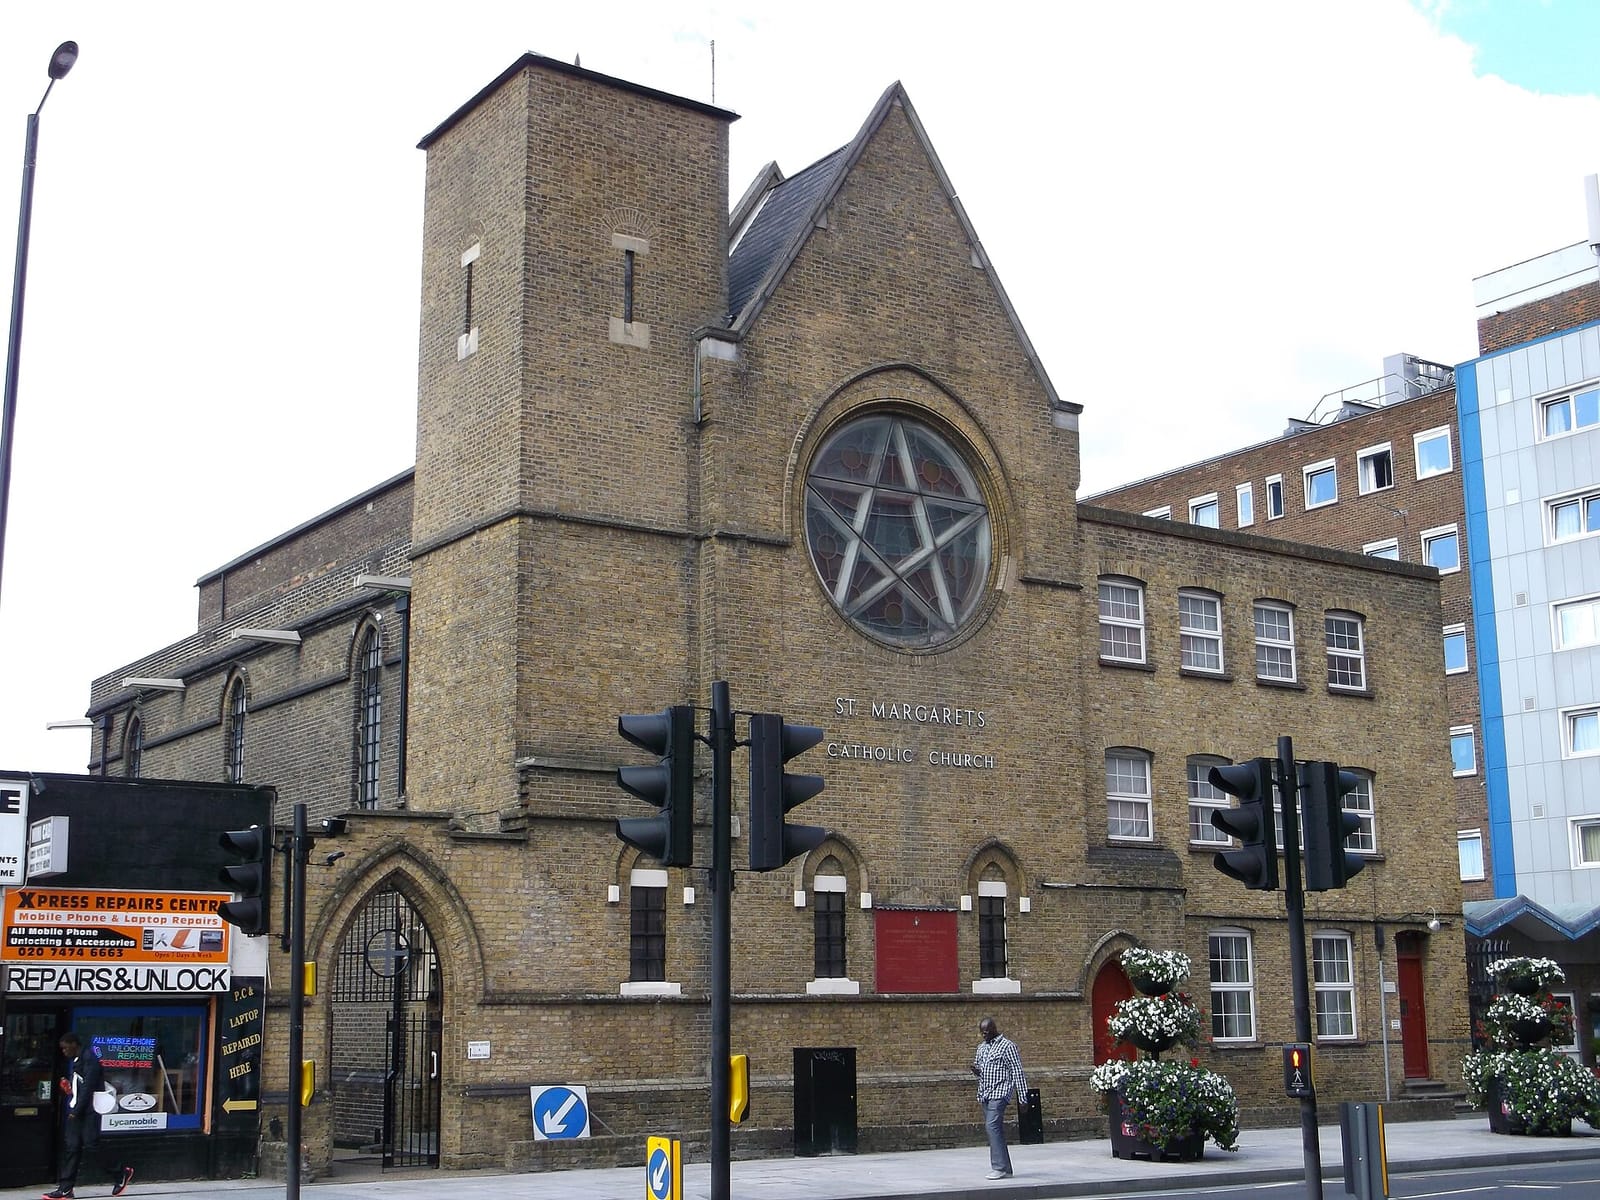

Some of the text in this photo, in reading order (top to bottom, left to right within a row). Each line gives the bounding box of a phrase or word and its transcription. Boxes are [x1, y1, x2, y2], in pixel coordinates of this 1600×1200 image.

[835, 697, 986, 728] ST. MARGARETS
[827, 743, 994, 769] CATHOLIC CHURCH
[18, 891, 89, 909] XPRESS
[96, 896, 164, 911] REPAIRS
[19, 912, 218, 926] Mobile Phone & Laptop Repairs
[11, 927, 98, 936] All Mobile Phone
[10, 937, 136, 947] Unlocking & Accessories
[18, 947, 124, 957] 020 7474 6663
[154, 951, 170, 959] Open
[176, 951, 190, 960] Days
[229, 1008, 260, 1028] LAPTOP
[106, 1037, 131, 1045] MOBILE
[131, 1038, 156, 1046] PHONE
[221, 1033, 261, 1056] REPAIRED
[107, 1044, 154, 1053] UNLOCKING
[117, 1052, 153, 1060] REPAIRS
[135, 1060, 153, 1068] HERE
[229, 1061, 252, 1080] HERE
[109, 1117, 158, 1127] Lycamobile
